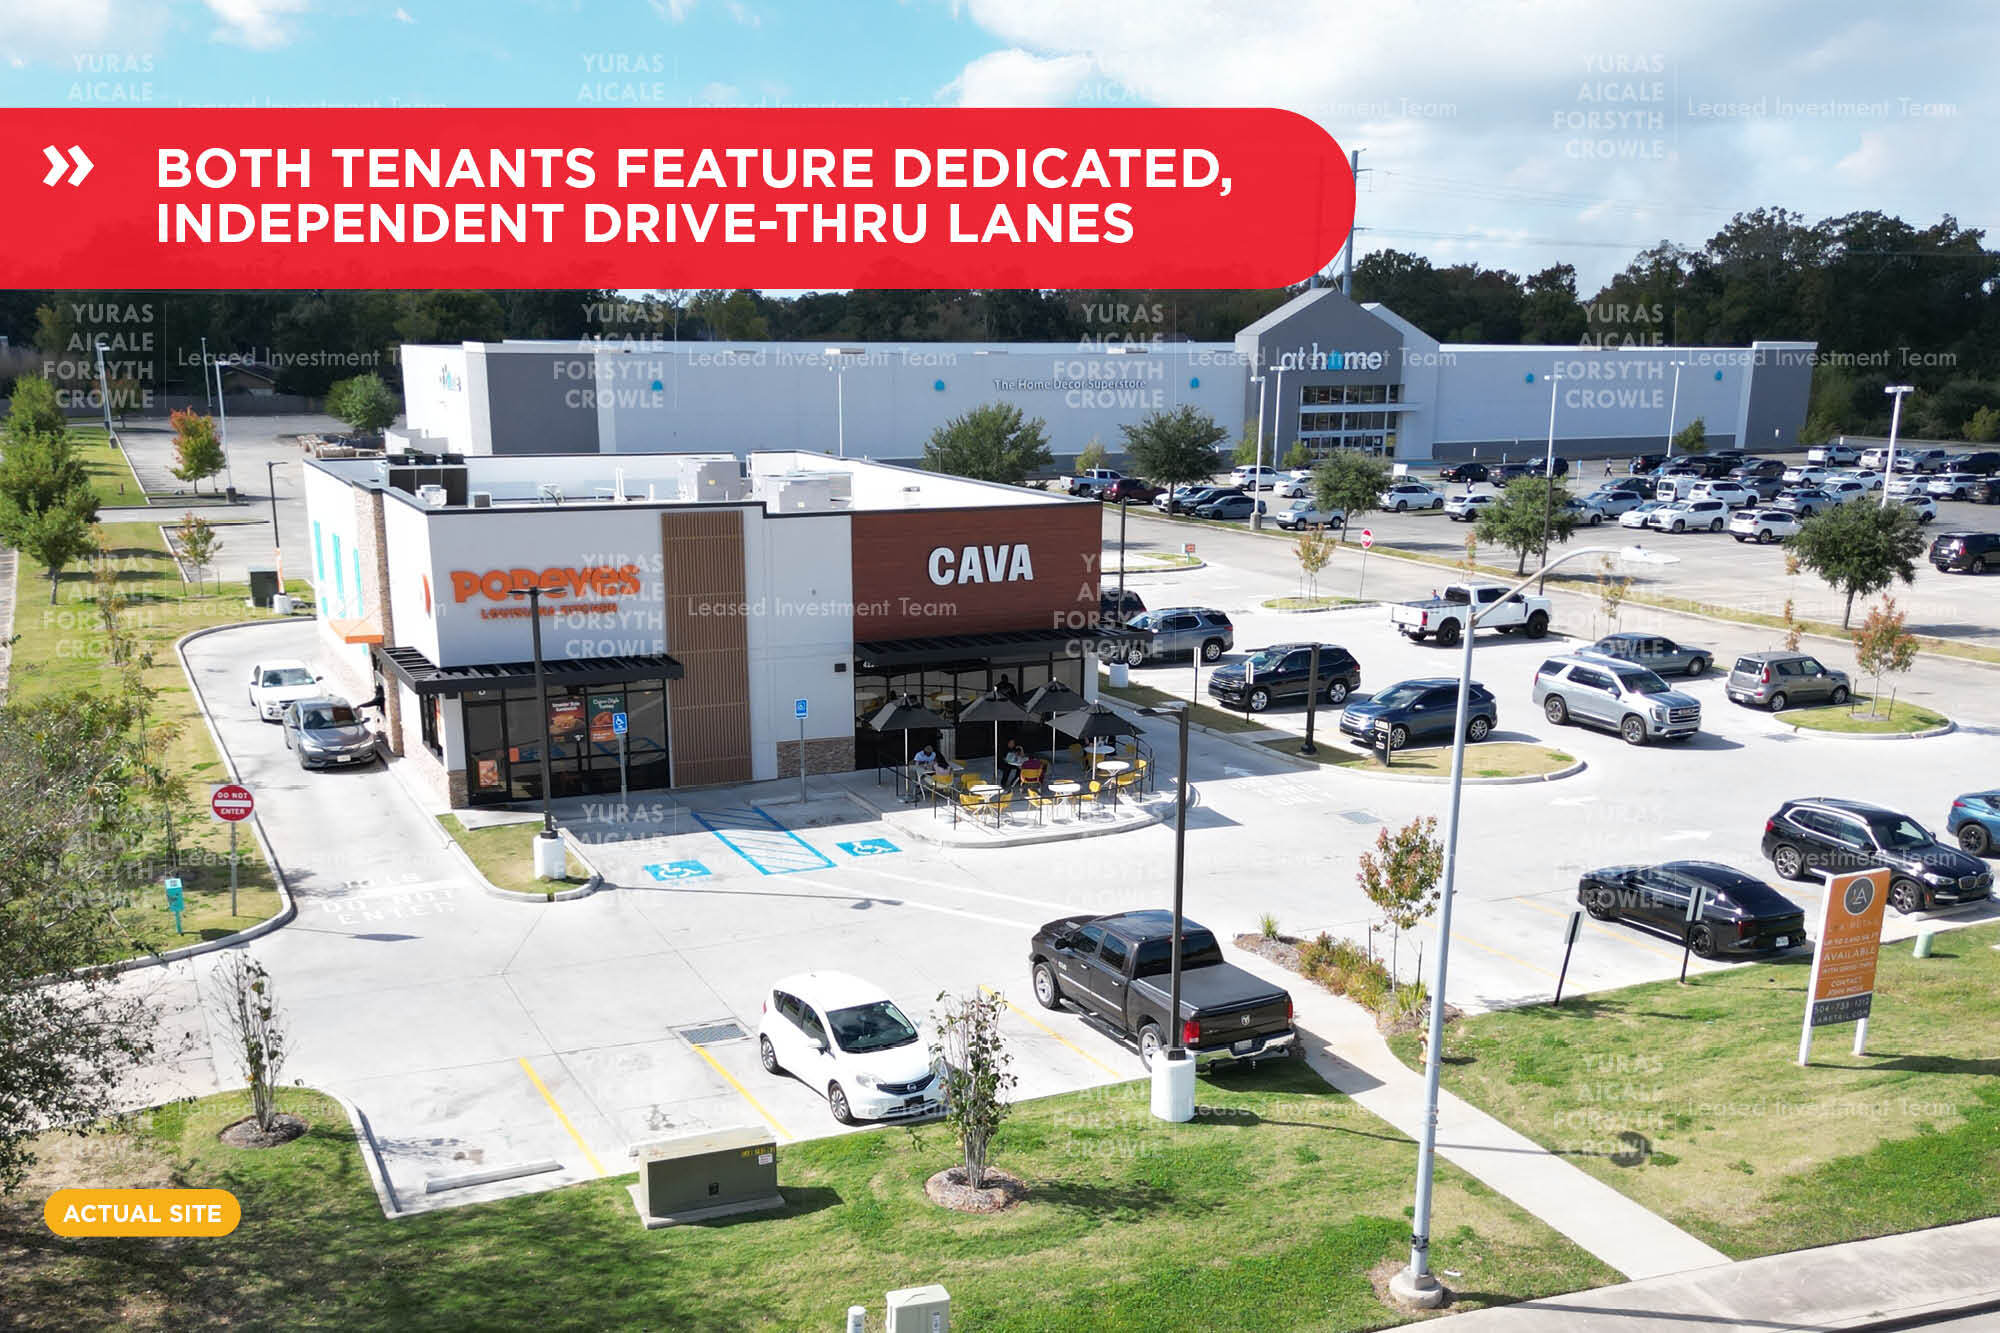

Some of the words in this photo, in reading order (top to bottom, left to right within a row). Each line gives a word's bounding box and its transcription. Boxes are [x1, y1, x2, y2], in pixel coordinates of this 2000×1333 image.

[994, 379, 1015, 390] The
[1016, 379, 1050, 390] Home
[1088, 378, 1146, 391] Superstore
[928, 543, 1034, 586] CAVA
[217, 791, 230, 799] DO
[220, 807, 246, 815] ENTER
[1823, 946, 1876, 962] AVAILABLE
